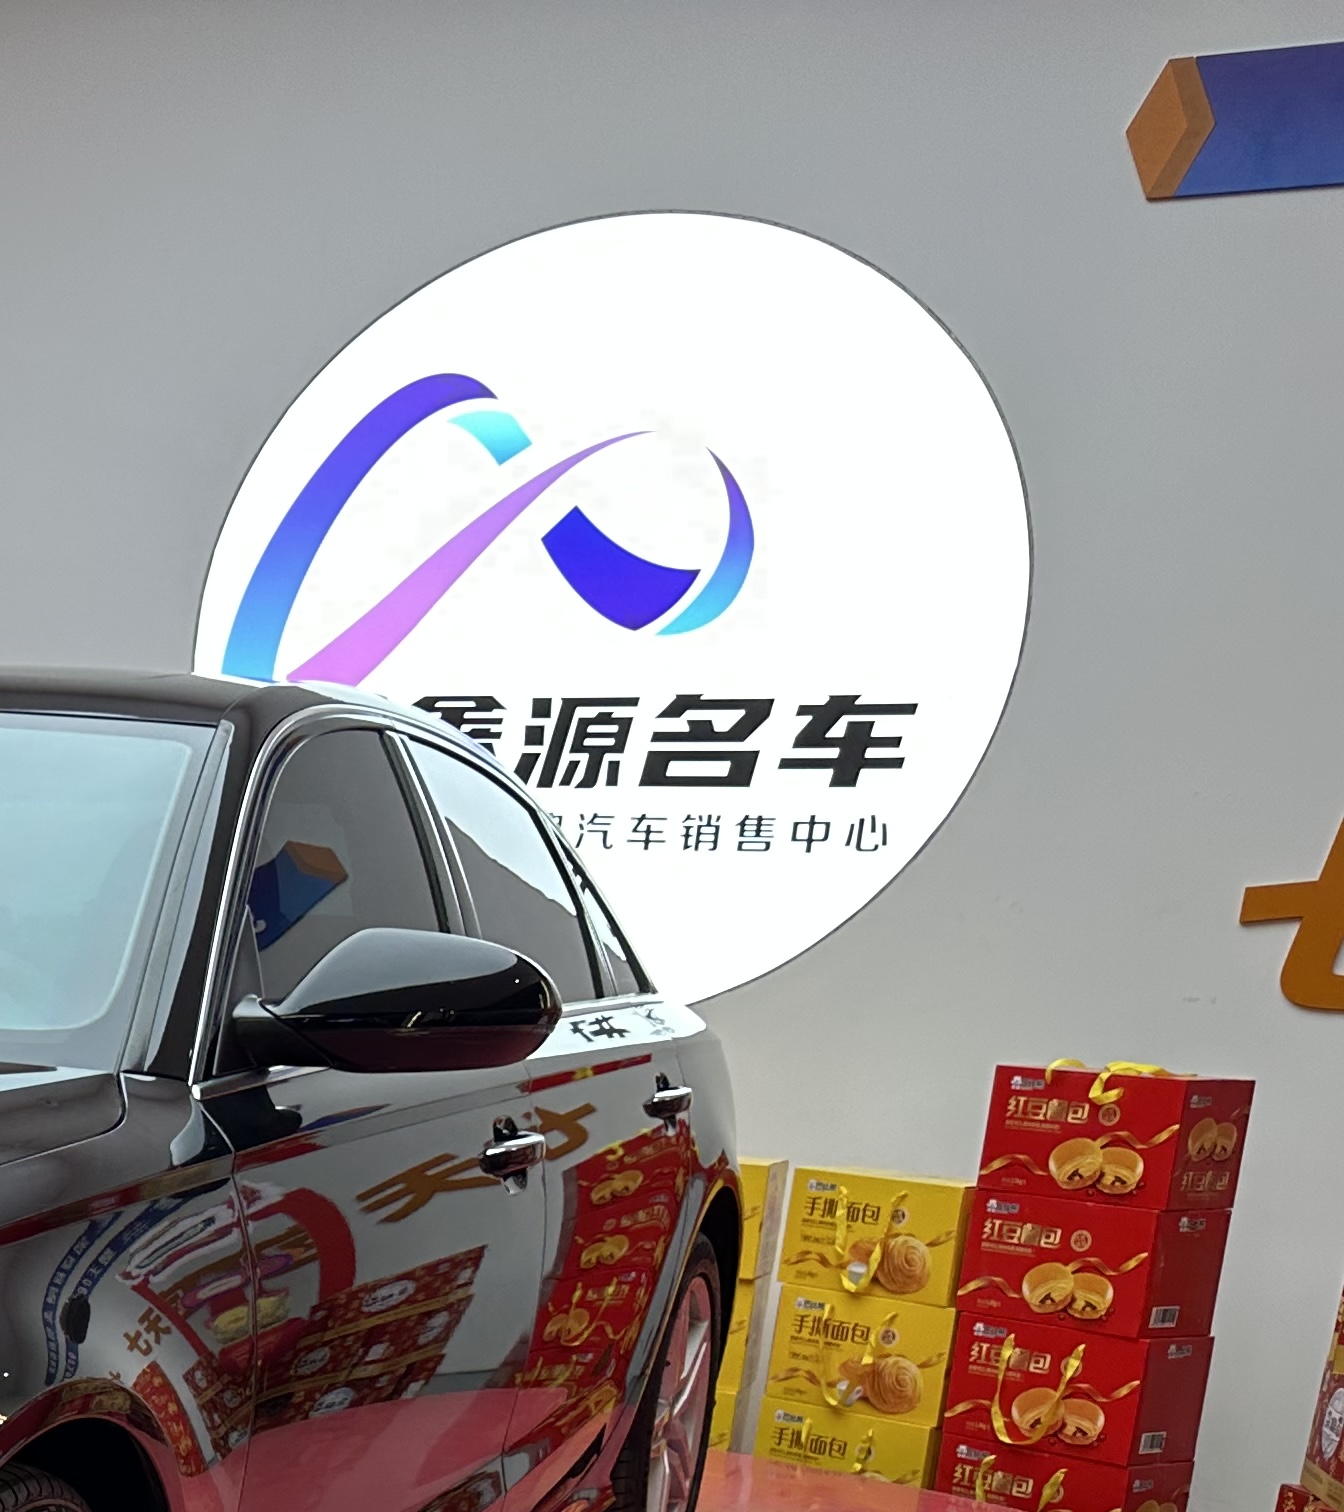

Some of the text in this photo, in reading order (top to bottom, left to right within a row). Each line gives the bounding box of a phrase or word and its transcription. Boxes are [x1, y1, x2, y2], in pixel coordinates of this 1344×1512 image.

[549, 812, 889, 854] 汽车销售中心
